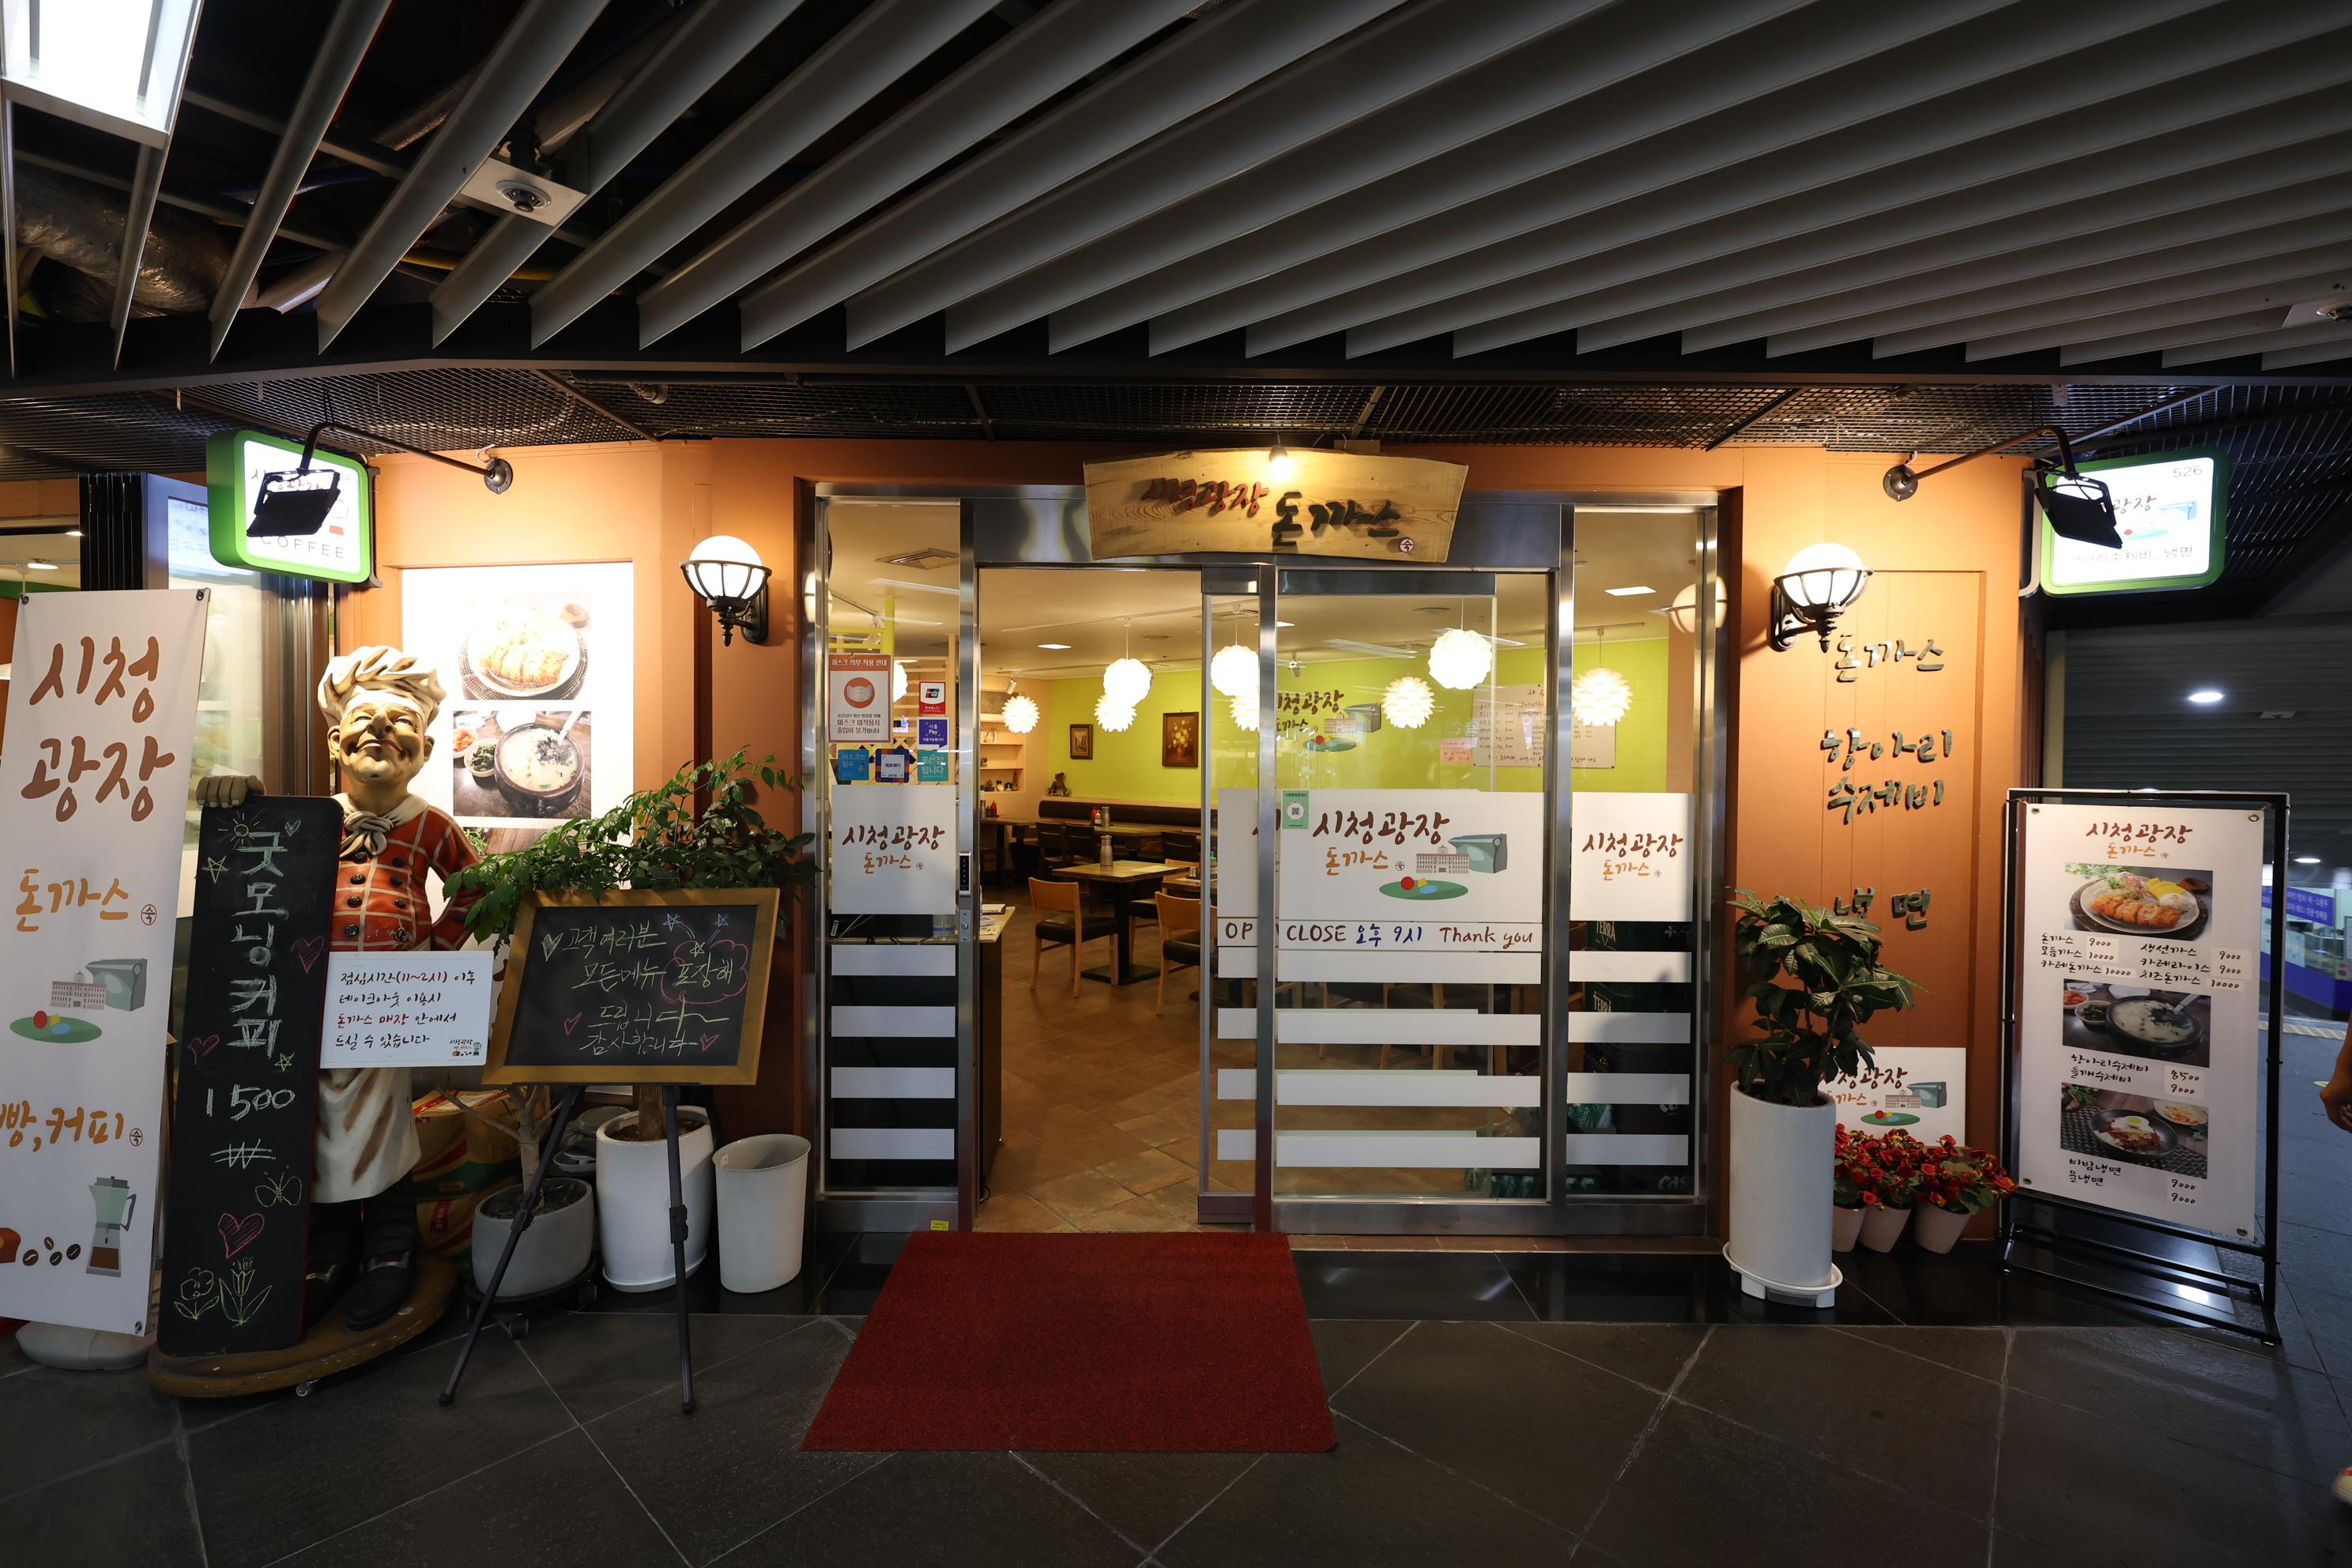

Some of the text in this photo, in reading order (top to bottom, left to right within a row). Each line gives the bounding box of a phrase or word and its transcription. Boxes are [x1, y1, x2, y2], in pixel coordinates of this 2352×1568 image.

[2173, 465, 2203, 478] 526
[1140, 477, 1269, 514] 시청광장
[2100, 495, 2157, 514] 광장
[1271, 491, 1401, 547] 돈까스
[260, 536, 345, 560] COFFEE
[2164, 546, 2193, 558] 냉면
[1835, 633, 1944, 682] 돈까스
[29, 635, 160, 723] 시청
[1820, 727, 1952, 771] 항아리
[21, 735, 175, 822] 광장
[1827, 775, 1945, 825] 수제비
[842, 824, 946, 850] 시청광장
[1312, 810, 1450, 845] 시청광장
[2085, 821, 2193, 845] 시청광장
[1581, 831, 1684, 858] 시청광장
[2106, 842, 2156, 859] 돈까스
[863, 852, 912, 875] 돈까스
[1325, 847, 1390, 876] 돈까스
[1603, 859, 1650, 881] 돈까스
[15, 869, 130, 933] 돈까스
[1286, 924, 1348, 942] CLOSE
[1355, 923, 1382, 948] 오후
[1393, 925, 1423, 944] 9시
[1439, 925, 1496, 944] Thank
[1502, 930, 1533, 949] you
[1596, 921, 1616, 943] TERRA
[2041, 933, 2112, 948] 돈까스 9000
[2041, 946, 2115, 961] 모듬까스 10000
[2139, 944, 2241, 961] 생선까스 9000
[454, 970, 476, 986] 이후
[674, 951, 733, 989] 포장해
[2040, 959, 2132, 977] 카레돈까스 10000
[2139, 958, 2241, 975] 카레라이스 9000
[2139, 970, 2240, 989] 치즈돈까스 10000
[339, 991, 441, 1008] 테이크아웃 이용시
[337, 1012, 457, 1028] 돈까스 매장 안에서
[588, 997, 730, 1038] 드립니다
[335, 1033, 431, 1050] 드실 수 있습니다
[579, 1029, 699, 1057] 감사합니다
[2070, 1067, 2196, 1095] 들깨수제비 9000
[2071, 1054, 2200, 1082] 항아리수제비 8500
[205, 1084, 296, 1121] 1500
[1827, 1091, 1867, 1106] 까스
[2068, 1170, 2196, 1204] 물냉면 9000
[2069, 1158, 2196, 1190] 비빔냉면 9000
